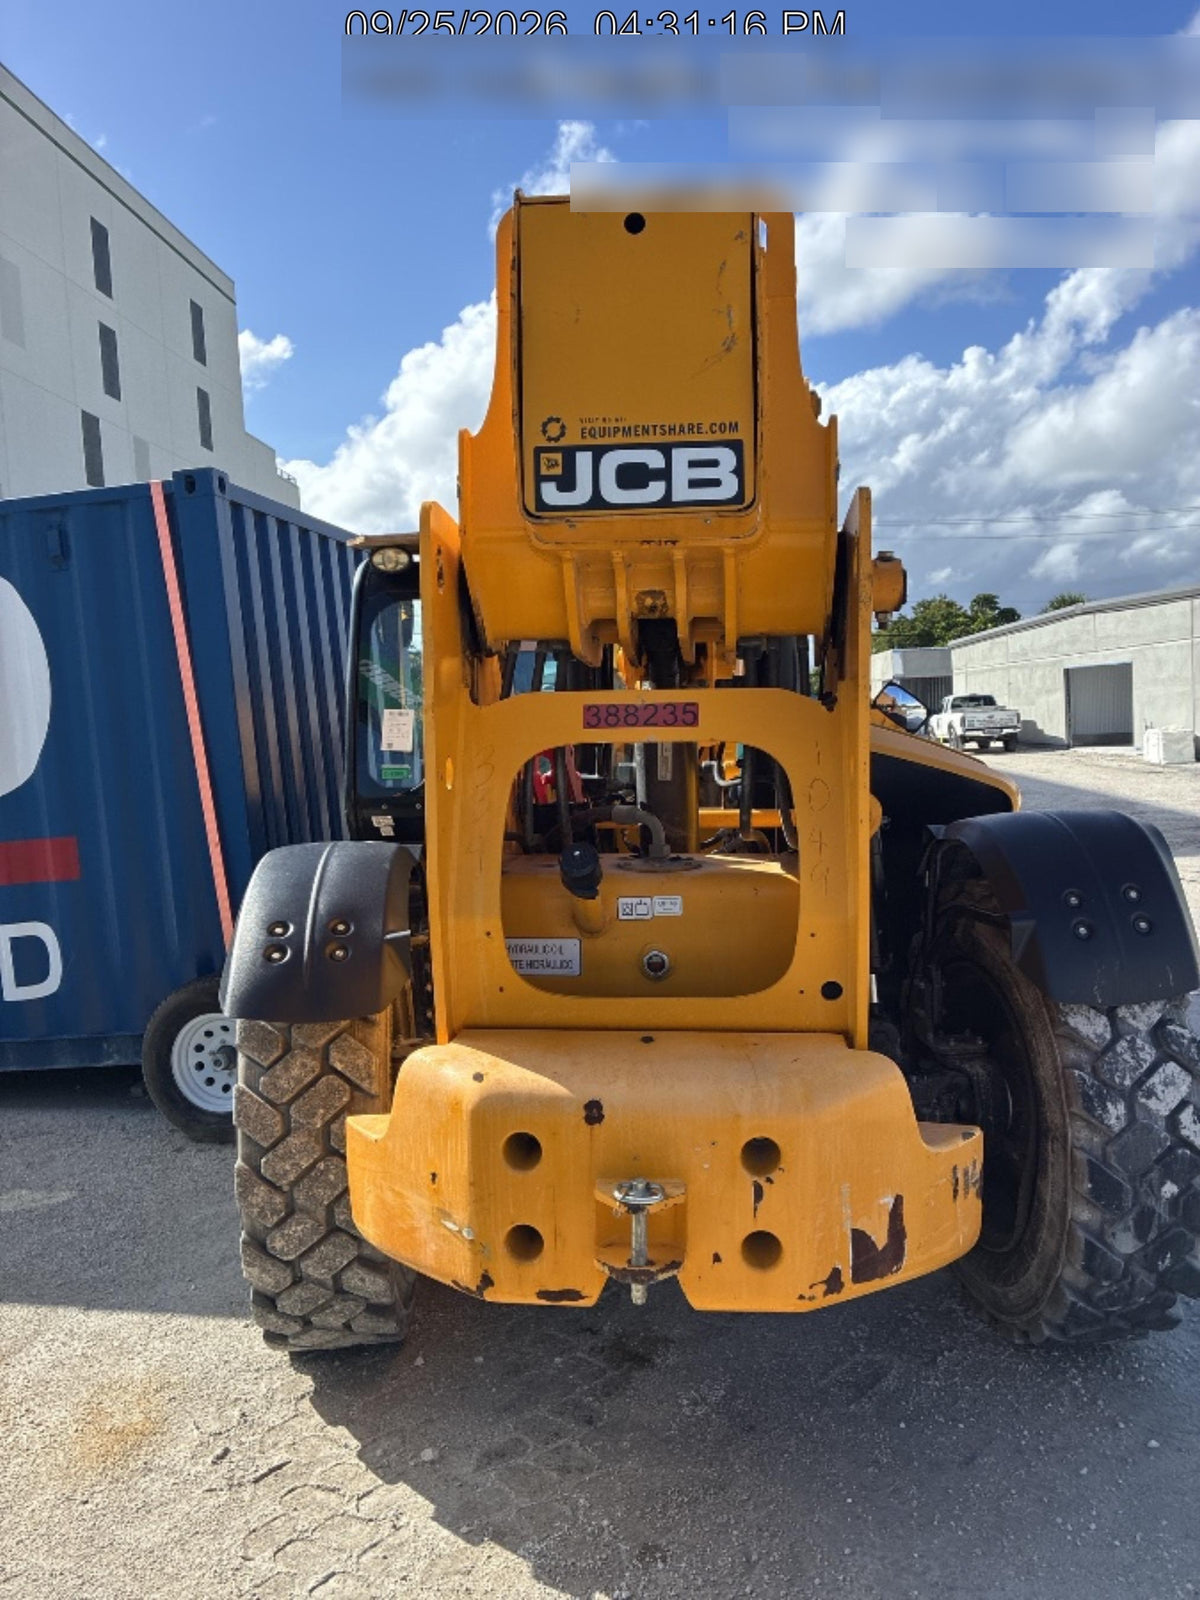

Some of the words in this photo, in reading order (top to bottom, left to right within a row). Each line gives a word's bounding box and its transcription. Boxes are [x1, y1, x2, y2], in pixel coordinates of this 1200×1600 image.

[580, 421, 739, 440] EQUIPMENTSHARE.COM
[540, 447, 739, 506] JCB
[585, 703, 697, 728] 388235
